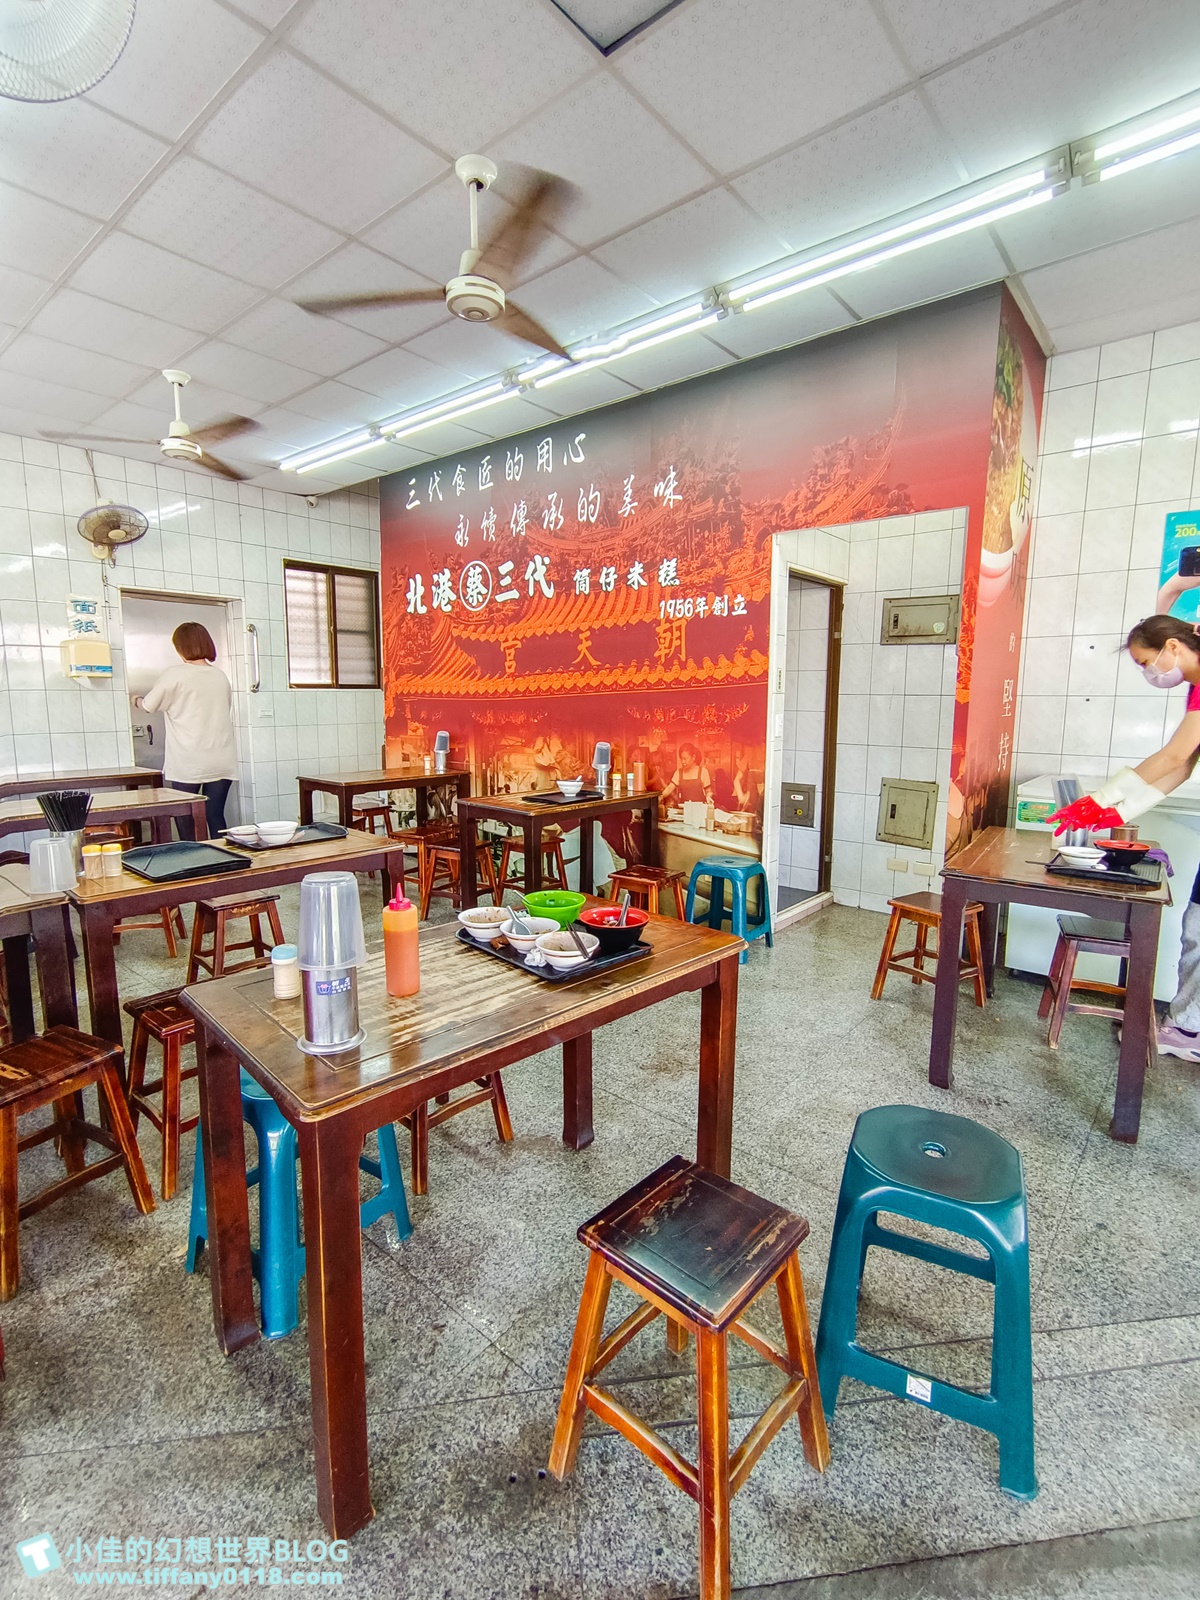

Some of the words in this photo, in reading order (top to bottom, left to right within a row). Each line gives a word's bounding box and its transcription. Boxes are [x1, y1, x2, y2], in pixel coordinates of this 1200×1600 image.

[405, 433, 587, 510] 三代食匠的用心
[455, 465, 684, 548] 永續傳承的美味
[70, 599, 100, 634] 面紙
[659, 593, 748, 619] 1956年創立
